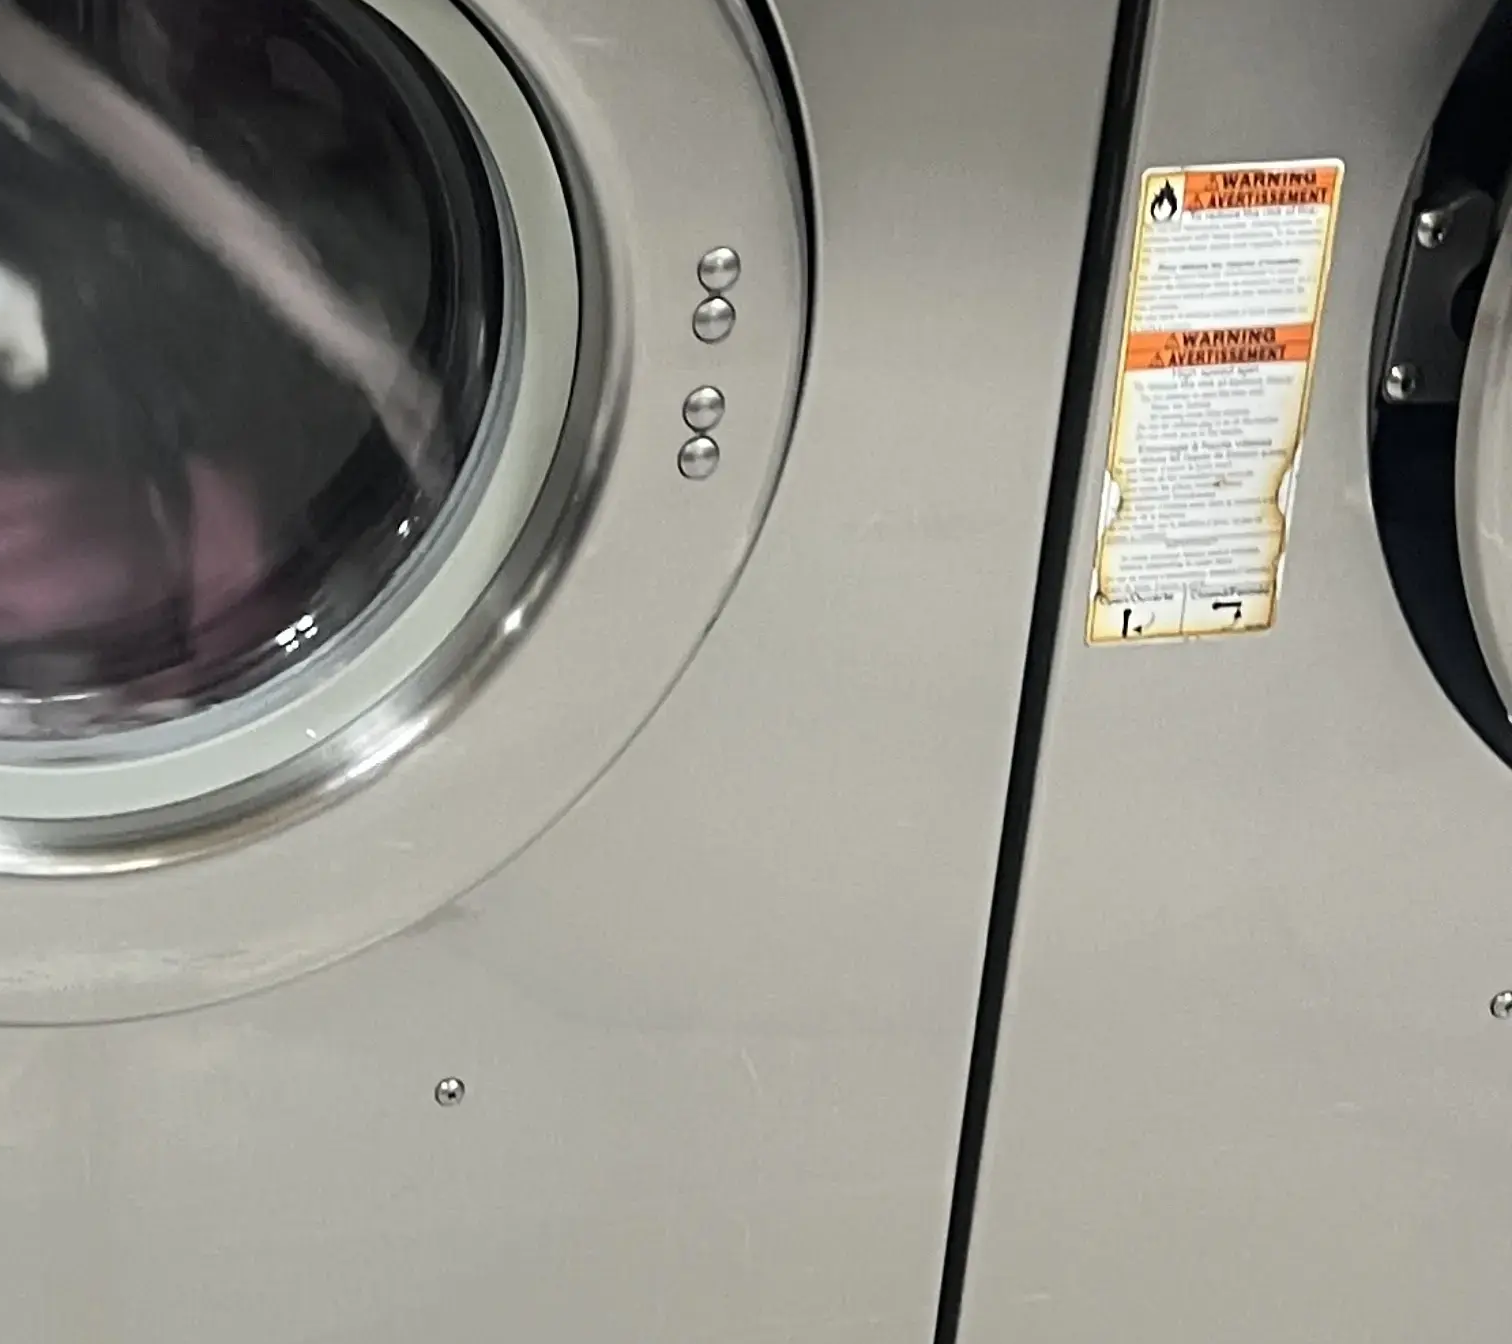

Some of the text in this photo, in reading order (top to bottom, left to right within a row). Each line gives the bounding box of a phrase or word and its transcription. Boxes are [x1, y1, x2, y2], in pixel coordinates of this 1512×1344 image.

[1222, 170, 1317, 189] WARNING
[1208, 187, 1328, 208] AVERTISSEMENT
[1182, 327, 1276, 347] WARNING
[1168, 344, 1286, 367] AVERTISSEMENT
